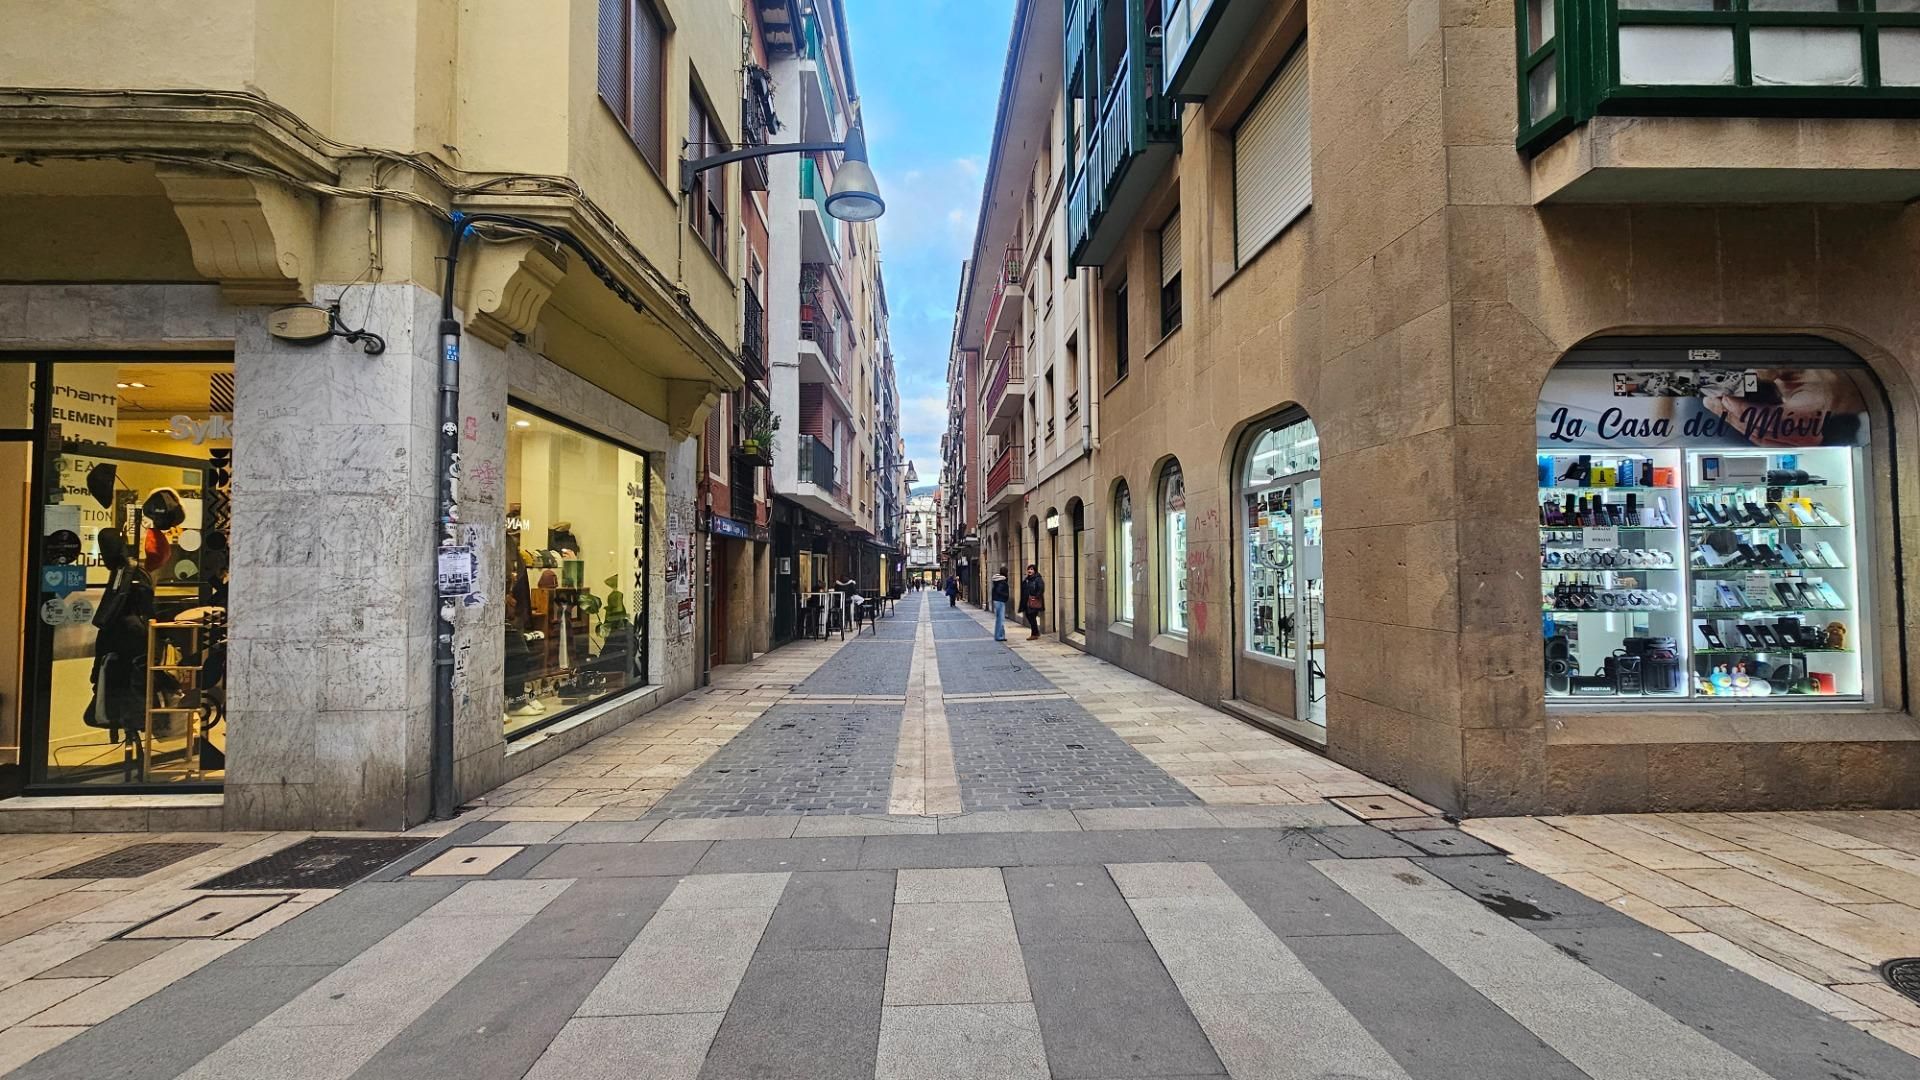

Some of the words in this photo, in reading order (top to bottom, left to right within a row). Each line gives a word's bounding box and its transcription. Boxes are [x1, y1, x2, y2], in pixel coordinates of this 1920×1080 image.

[30, 381, 117, 406] crhartt
[53, 407, 114, 428] ELEMENT
[1550, 407, 1587, 443] La
[1598, 407, 1674, 440] Casa
[1683, 407, 1729, 440] del
[1739, 406, 1829, 440] Móvil
